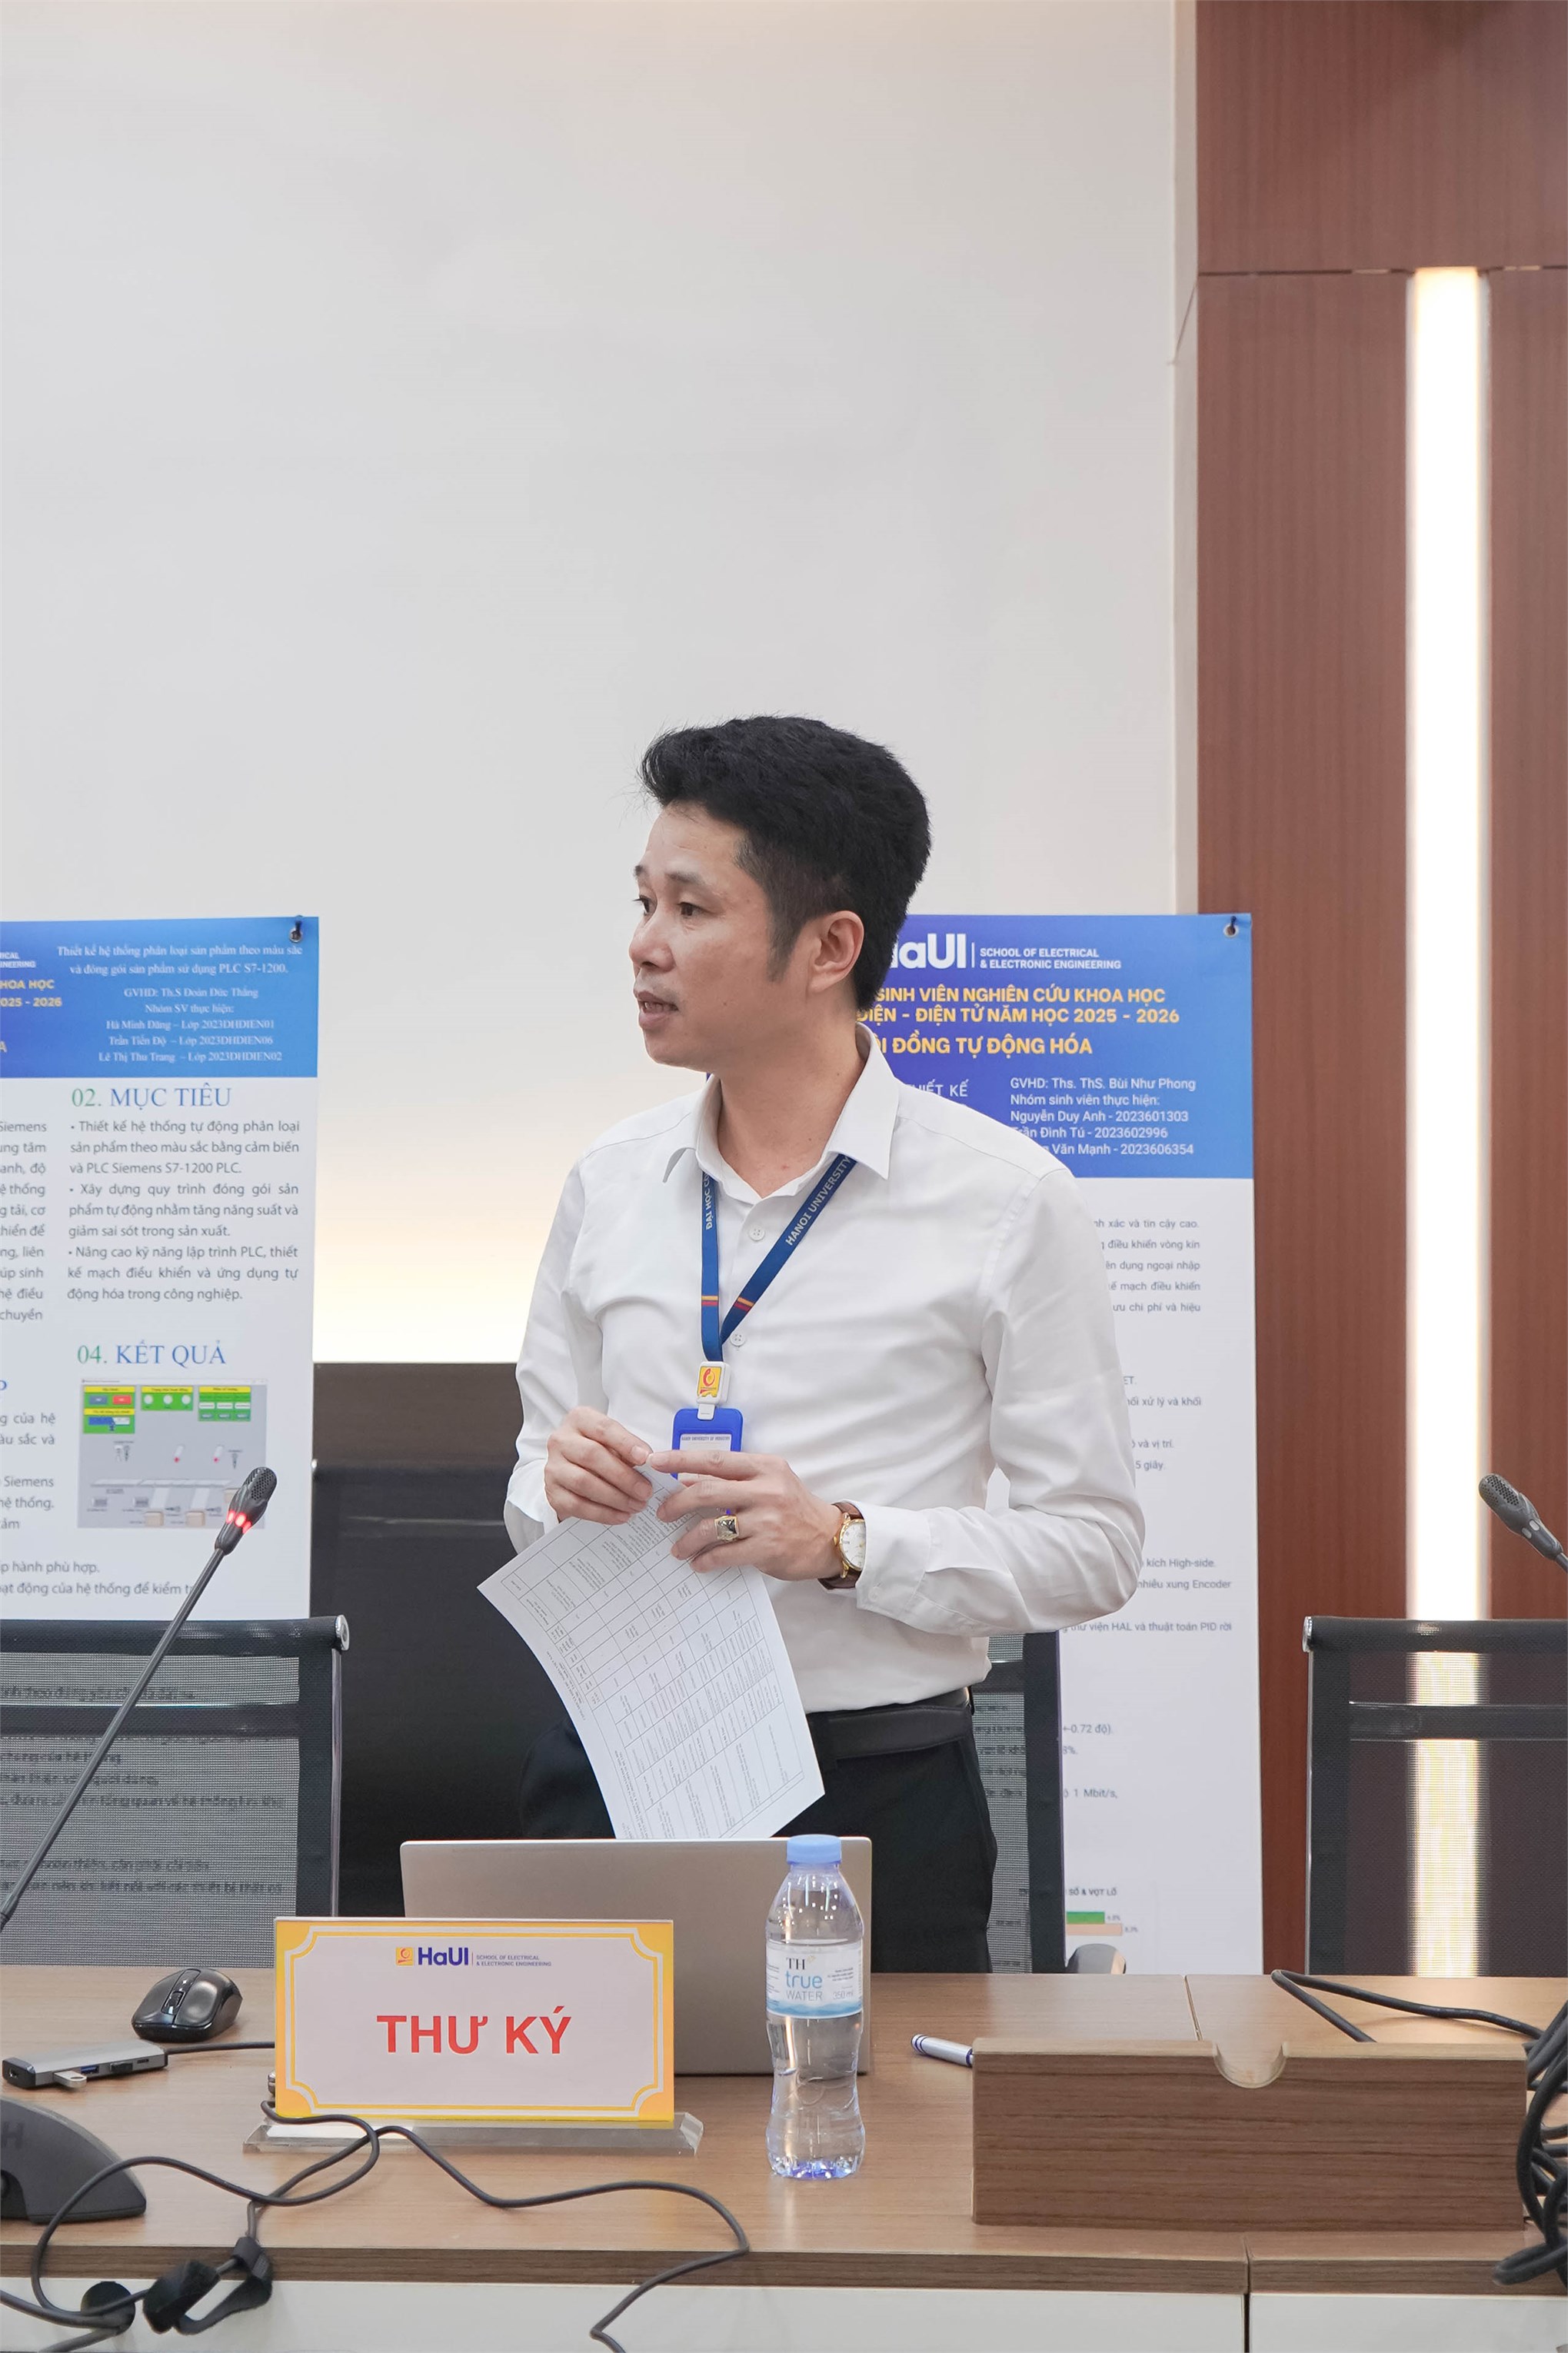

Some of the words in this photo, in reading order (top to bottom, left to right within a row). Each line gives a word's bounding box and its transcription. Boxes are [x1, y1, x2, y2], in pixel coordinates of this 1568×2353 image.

[980, 948, 1021, 957] SCHOOL
[1024, 948, 1037, 957] OF
[1039, 948, 1099, 957] ELECTRICAL
[219, 963, 241, 973] PLC
[980, 960, 987, 968] &
[990, 960, 1051, 968] ELECTRONIC
[1054, 960, 1121, 969] ENGINEERING
[28, 980, 55, 990] HỌC
[876, 987, 914, 1003] SINH
[919, 983, 959, 1002] VIÊN
[964, 984, 1028, 1002] NGHIÊN
[1033, 983, 1070, 1003] CỨU
[1074, 988, 1124, 1003] KHOA
[1128, 988, 1165, 1006] HỌC
[33, 997, 62, 1007] 2026
[915, 1004, 956, 1026] ĐIỆN
[960, 1003, 984, 1022] TỬ
[987, 1005, 1027, 1022] NĂM
[1031, 1008, 1069, 1026] HỌC
[1074, 1008, 1117, 1023] 2025
[1137, 1009, 1180, 1023] 2026
[892, 1030, 950, 1054] ĐỒNG
[956, 1036, 984, 1058] TỰ
[987, 1033, 1045, 1058] ĐỘNG
[1050, 1033, 1092, 1054] HÓA
[950, 1079, 969, 1097] KẾ
[1010, 1077, 1048, 1088] GVHD:
[1053, 1077, 1076, 1089] Ths.
[1080, 1077, 1105, 1089] ThS.
[1110, 1078, 1128, 1089] Bùi
[1131, 1078, 1155, 1089] Như
[1159, 1078, 1196, 1091] Phong
[72, 1088, 101, 1107] 02.
[111, 1088, 166, 1109] MỤC
[175, 1083, 230, 1106] TIÊU
[1010, 1094, 1046, 1105] Nhóm
[1049, 1094, 1073, 1105] sinh
[1076, 1094, 1100, 1105] viên
[1103, 1094, 1129, 1107] thực
[1133, 1094, 1160, 1107] hiện:
[1011, 1110, 1054, 1123] Nguyễn
[1058, 1110, 1079, 1123] Duy
[1083, 1110, 1106, 1121] Anh
[1116, 1110, 1189, 1123] 2023601303
[78, 1120, 108, 1132] Thiết
[113, 1120, 127, 1131] kế
[131, 1120, 146, 1132] hệ
[150, 1120, 186, 1134] thống
[191, 1122, 204, 1131] tự
[207, 1120, 238, 1134] động
[244, 1120, 274, 1133] phân
[278, 1120, 299, 1133] loại
[1040, 1127, 1067, 1137] Đình
[1070, 1127, 1085, 1137] Tú
[1094, 1127, 1168, 1138] 2023602996
[71, 1142, 90, 1153] sản
[93, 1140, 128, 1155] phẩm
[131, 1142, 158, 1153] theo
[161, 1142, 187, 1152] màu
[190, 1141, 208, 1152] sắc
[211, 1141, 241, 1155] bằng
[245, 1141, 270, 1152] cảm
[273, 1141, 299, 1152] biến
[1052, 1143, 1075, 1154] Văn
[1078, 1143, 1110, 1156] Mạnh
[1120, 1143, 1193, 1155] 2023606354
[70, 1163, 83, 1173] và
[87, 1163, 108, 1173] PLC
[112, 1163, 161, 1173] Siemens
[165, 1163, 213, 1173] S7-1200
[217, 1163, 241, 1173] PLC.
[81, 1184, 102, 1197] Xây
[109, 1183, 140, 1197] dựng
[148, 1186, 171, 1196] quy
[178, 1183, 205, 1194] trình
[213, 1183, 245, 1197] đóng
[252, 1183, 271, 1197] gói
[278, 1183, 298, 1194] sản
[704, 1187, 714, 1206] HỌC
[785, 1213, 812, 1246] HANOI
[809, 1157, 852, 1211] UNIVERSITY
[69, 1203, 103, 1217] phẩm
[106, 1206, 120, 1217] tự
[122, 1204, 153, 1218] động
[156, 1203, 190, 1215] nhằm
[193, 1205, 220, 1218] tăng
[224, 1205, 254, 1218] năng
[257, 1204, 281, 1215] suất
[285, 1204, 298, 1215] và
[76, 1246, 107, 1260] Nâng
[111, 1249, 132, 1257] cao
[136, 1246, 149, 1260] kỹ
[153, 1246, 182, 1260] năng
[187, 1246, 205, 1260] lập
[208, 1246, 237, 1257] trình
[241, 1246, 266, 1257] PLC,
[270, 1246, 298, 1257] thiết
[78, 1346, 107, 1363] 04.
[117, 1340, 165, 1364] KẾT
[172, 1340, 225, 1368] QUẢ
[12, 1561, 42, 1572] hành
[46, 1562, 69, 1574] phù
[1147, 1559, 1166, 1567] kích
[1169, 1559, 1215, 1569] High-side.
[1167, 1582, 1189, 1590] xung
[1193, 1579, 1231, 1589] Encoder
[1088, 1622, 1109, 1632] viện
[1112, 1622, 1132, 1631] HAL
[1135, 1622, 1146, 1631] và
[1149, 1622, 1174, 1632] thuật
[1177, 1622, 1197, 1631] toán
[1200, 1622, 1217, 1631] PID
[1084, 1789, 1117, 1798] Mbit/s,
[418, 1947, 468, 1965] HaUI
[785, 1957, 806, 1971] TH
[785, 1970, 823, 1989] true
[786, 1990, 823, 2002] WATER
[377, 2015, 488, 2054] THƯ
[506, 2006, 571, 2055] KÝ
